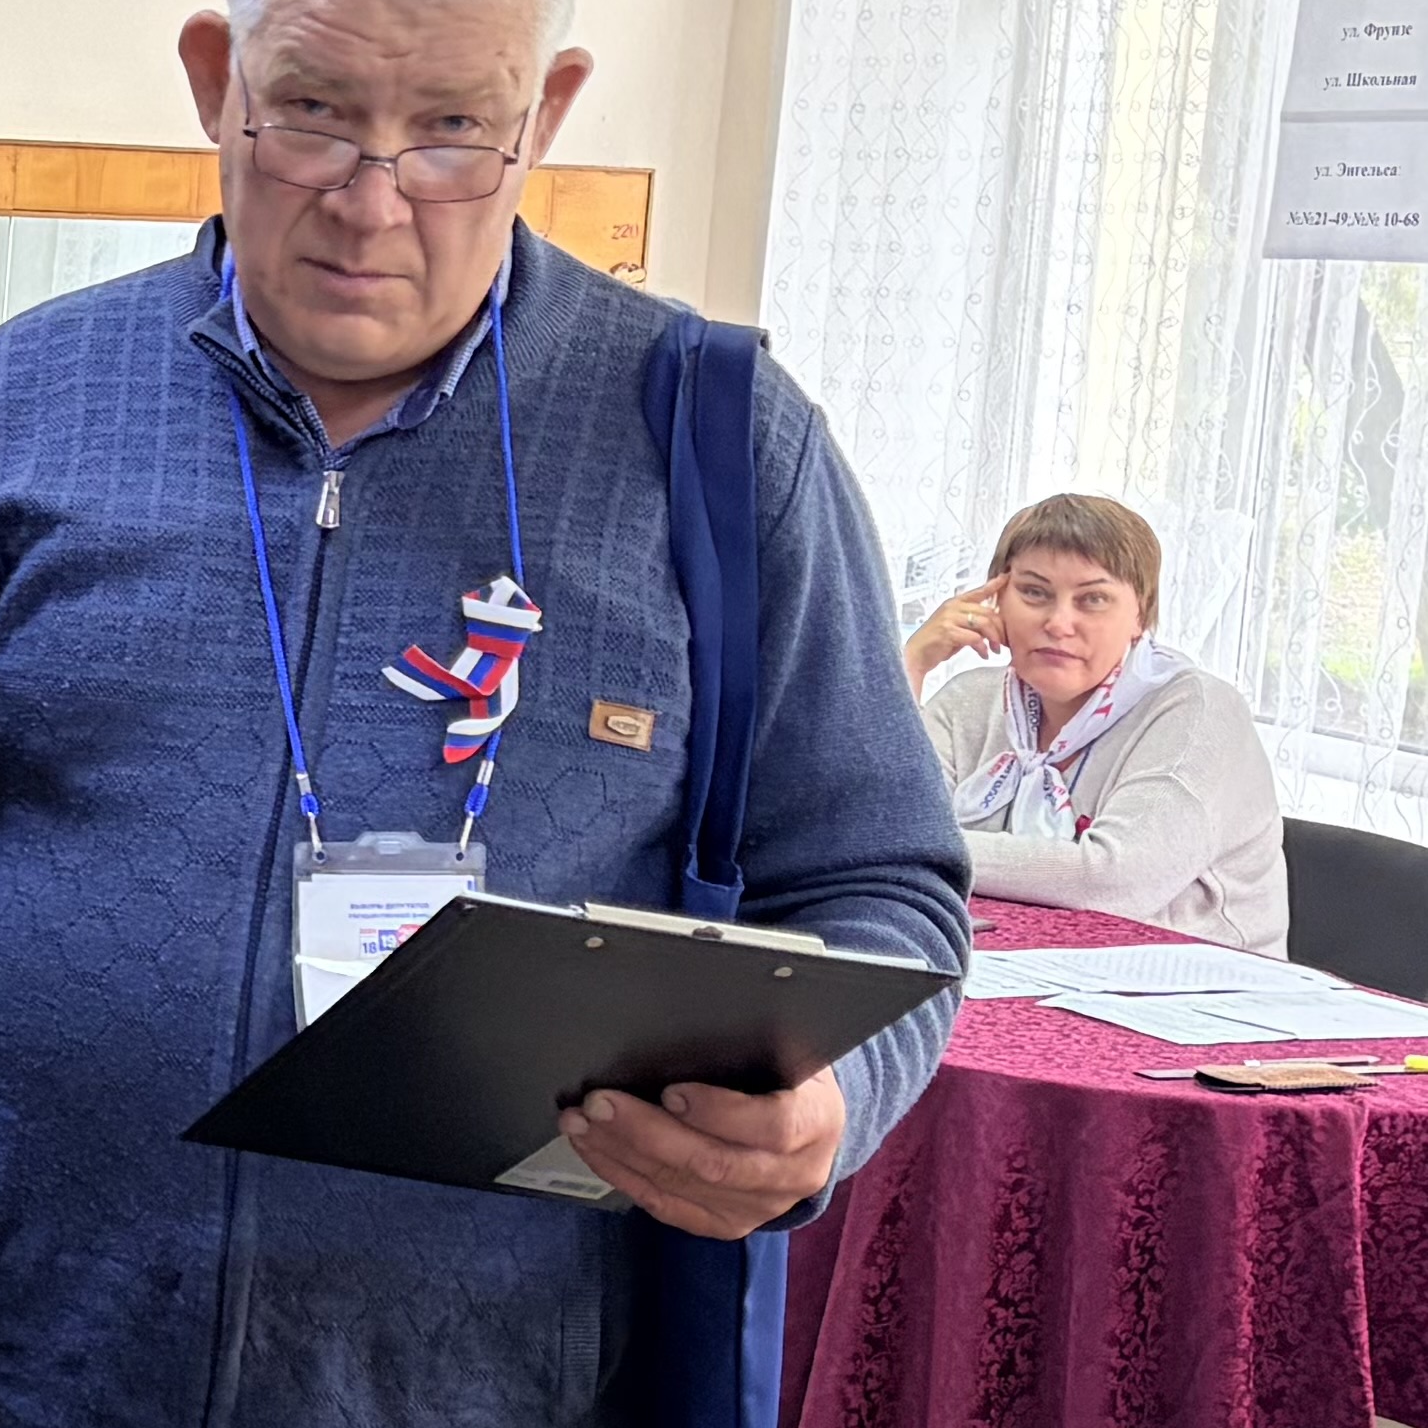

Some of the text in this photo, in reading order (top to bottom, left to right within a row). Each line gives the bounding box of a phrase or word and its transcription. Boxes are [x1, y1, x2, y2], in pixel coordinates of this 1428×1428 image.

[1340, 21, 1414, 42] ул. Фрунзе
[1323, 72, 1418, 91] ул. Школьная
[1383, 211, 1421, 228] 10-68
[362, 941, 377, 954] 18
